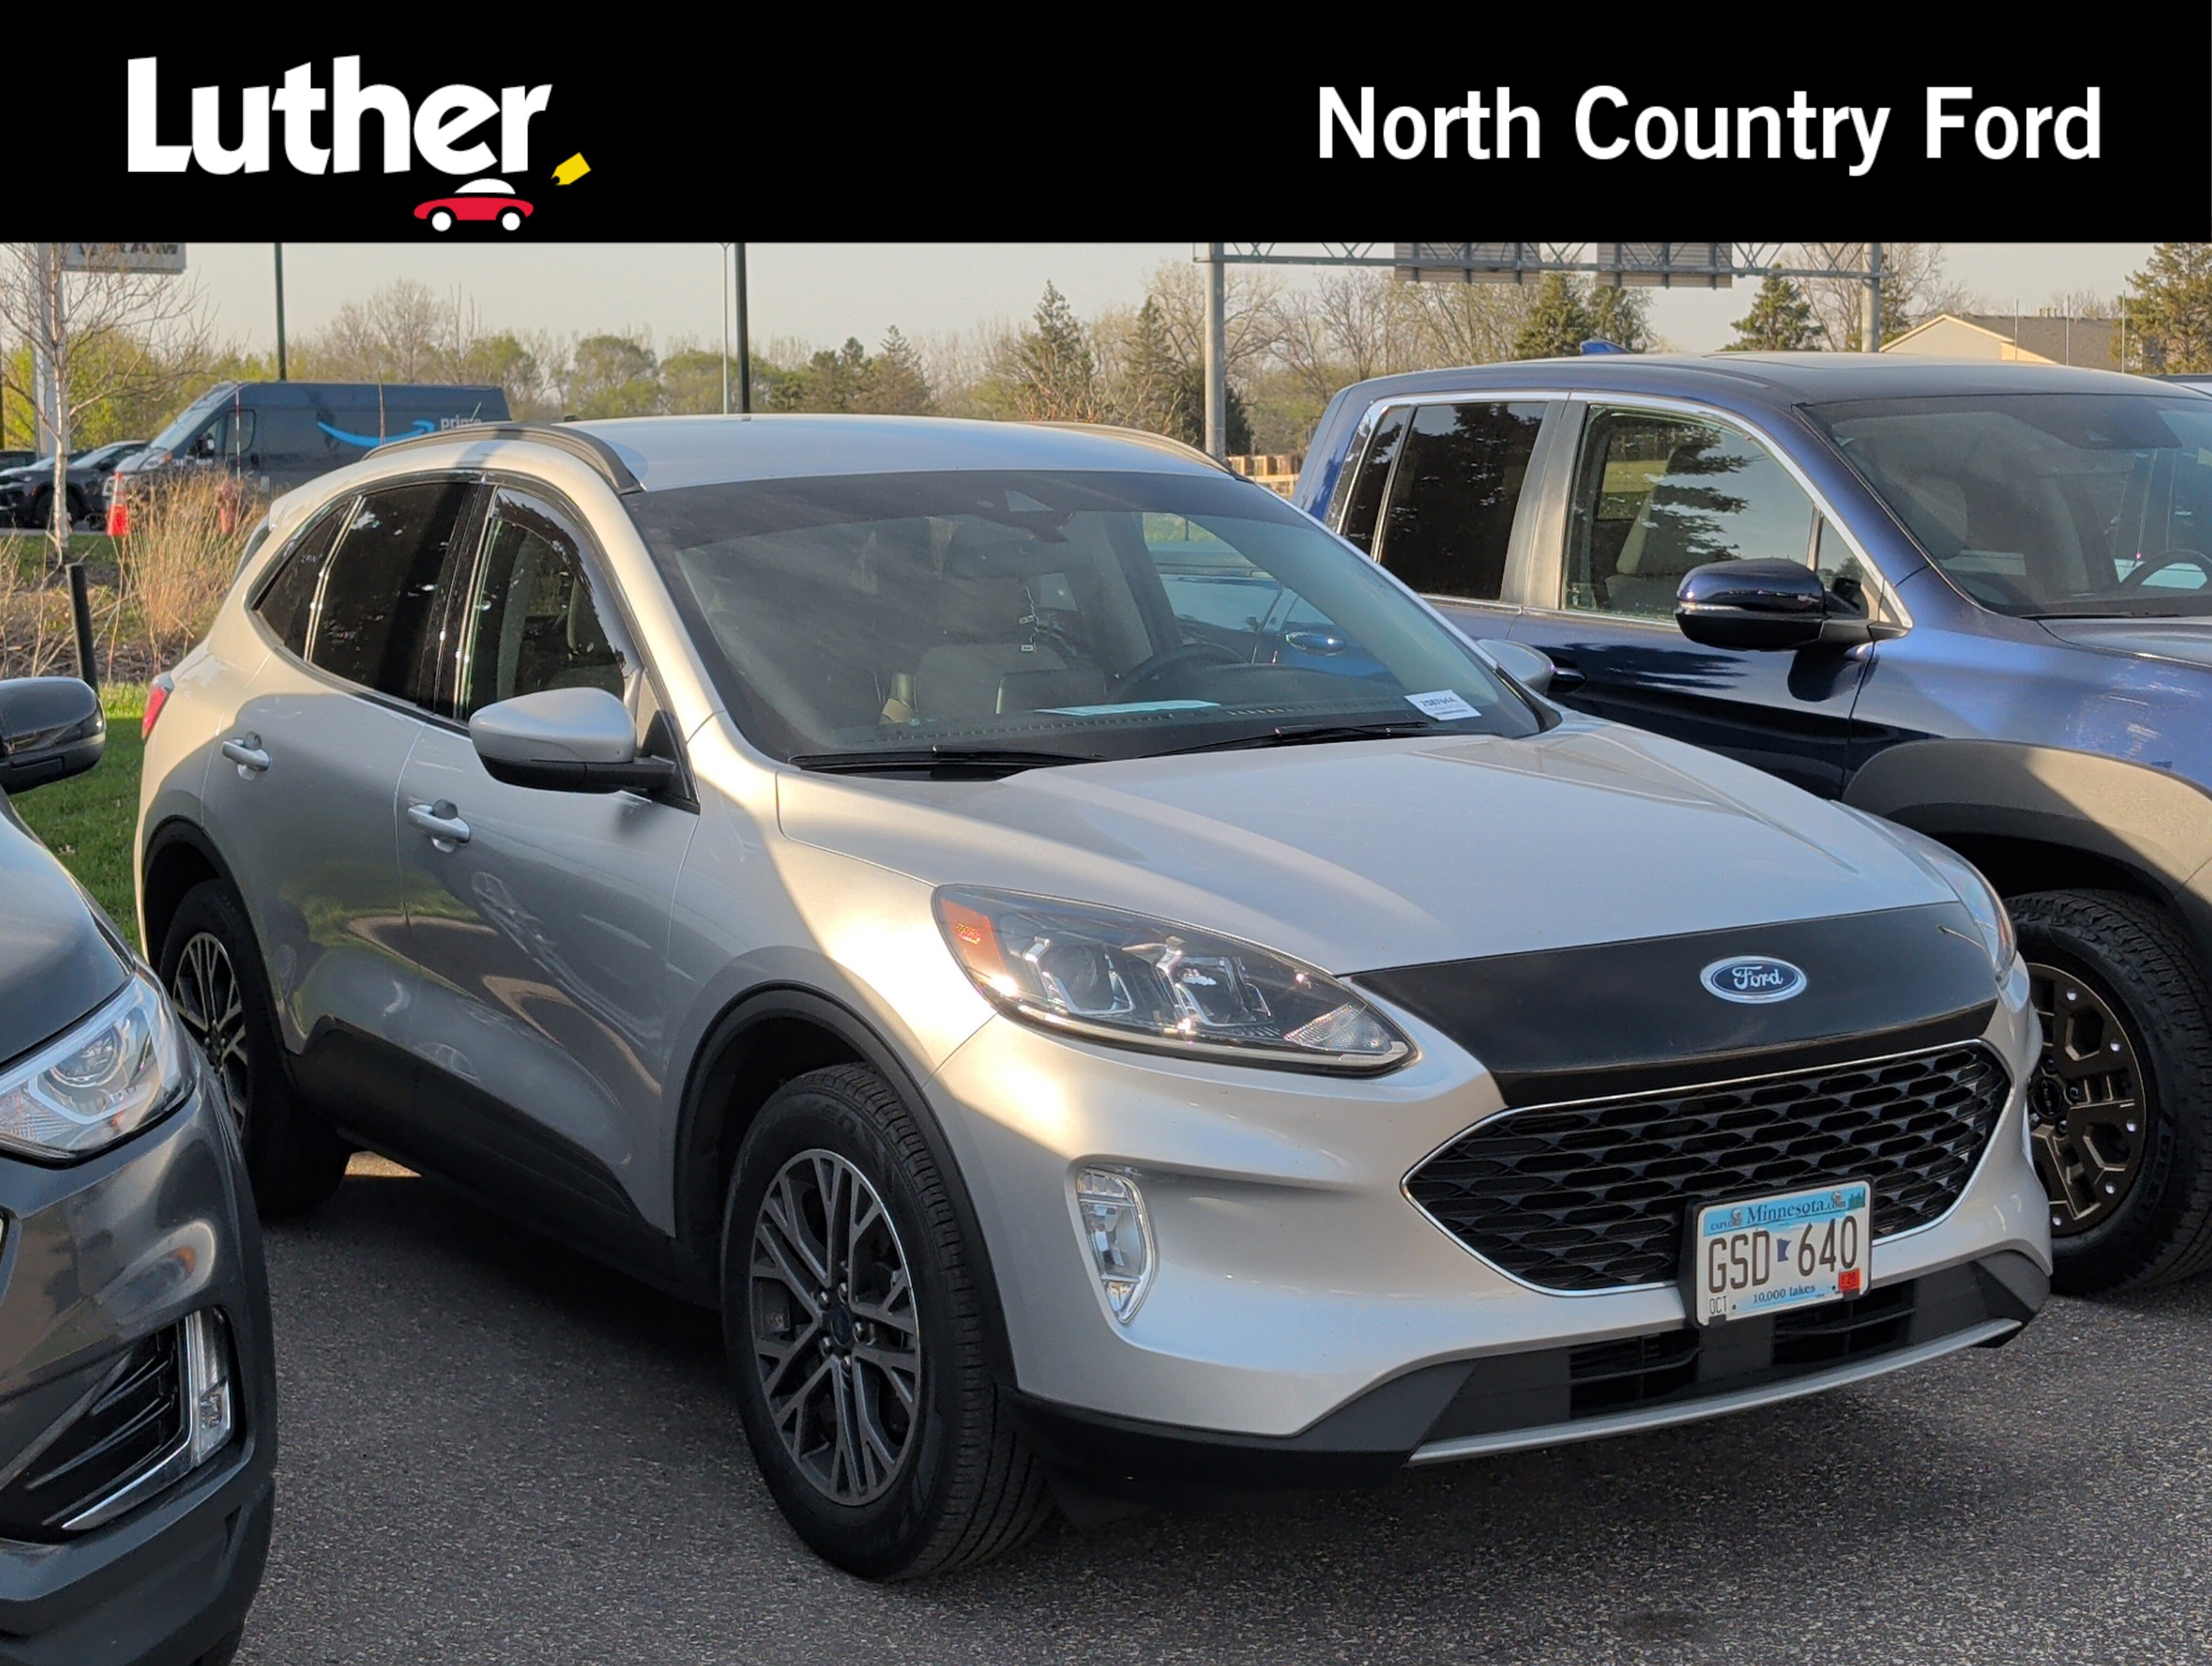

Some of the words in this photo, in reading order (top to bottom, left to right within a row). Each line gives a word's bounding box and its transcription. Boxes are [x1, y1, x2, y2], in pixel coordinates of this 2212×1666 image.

[1732, 965, 1784, 989] Ford
[1708, 1229, 1770, 1293] GSD
[1798, 1215, 1857, 1277] 640
[1753, 1289, 1786, 1303] 10,000
[1789, 1284, 1816, 1299] lakes
[1709, 1295, 1727, 1315] OCT
